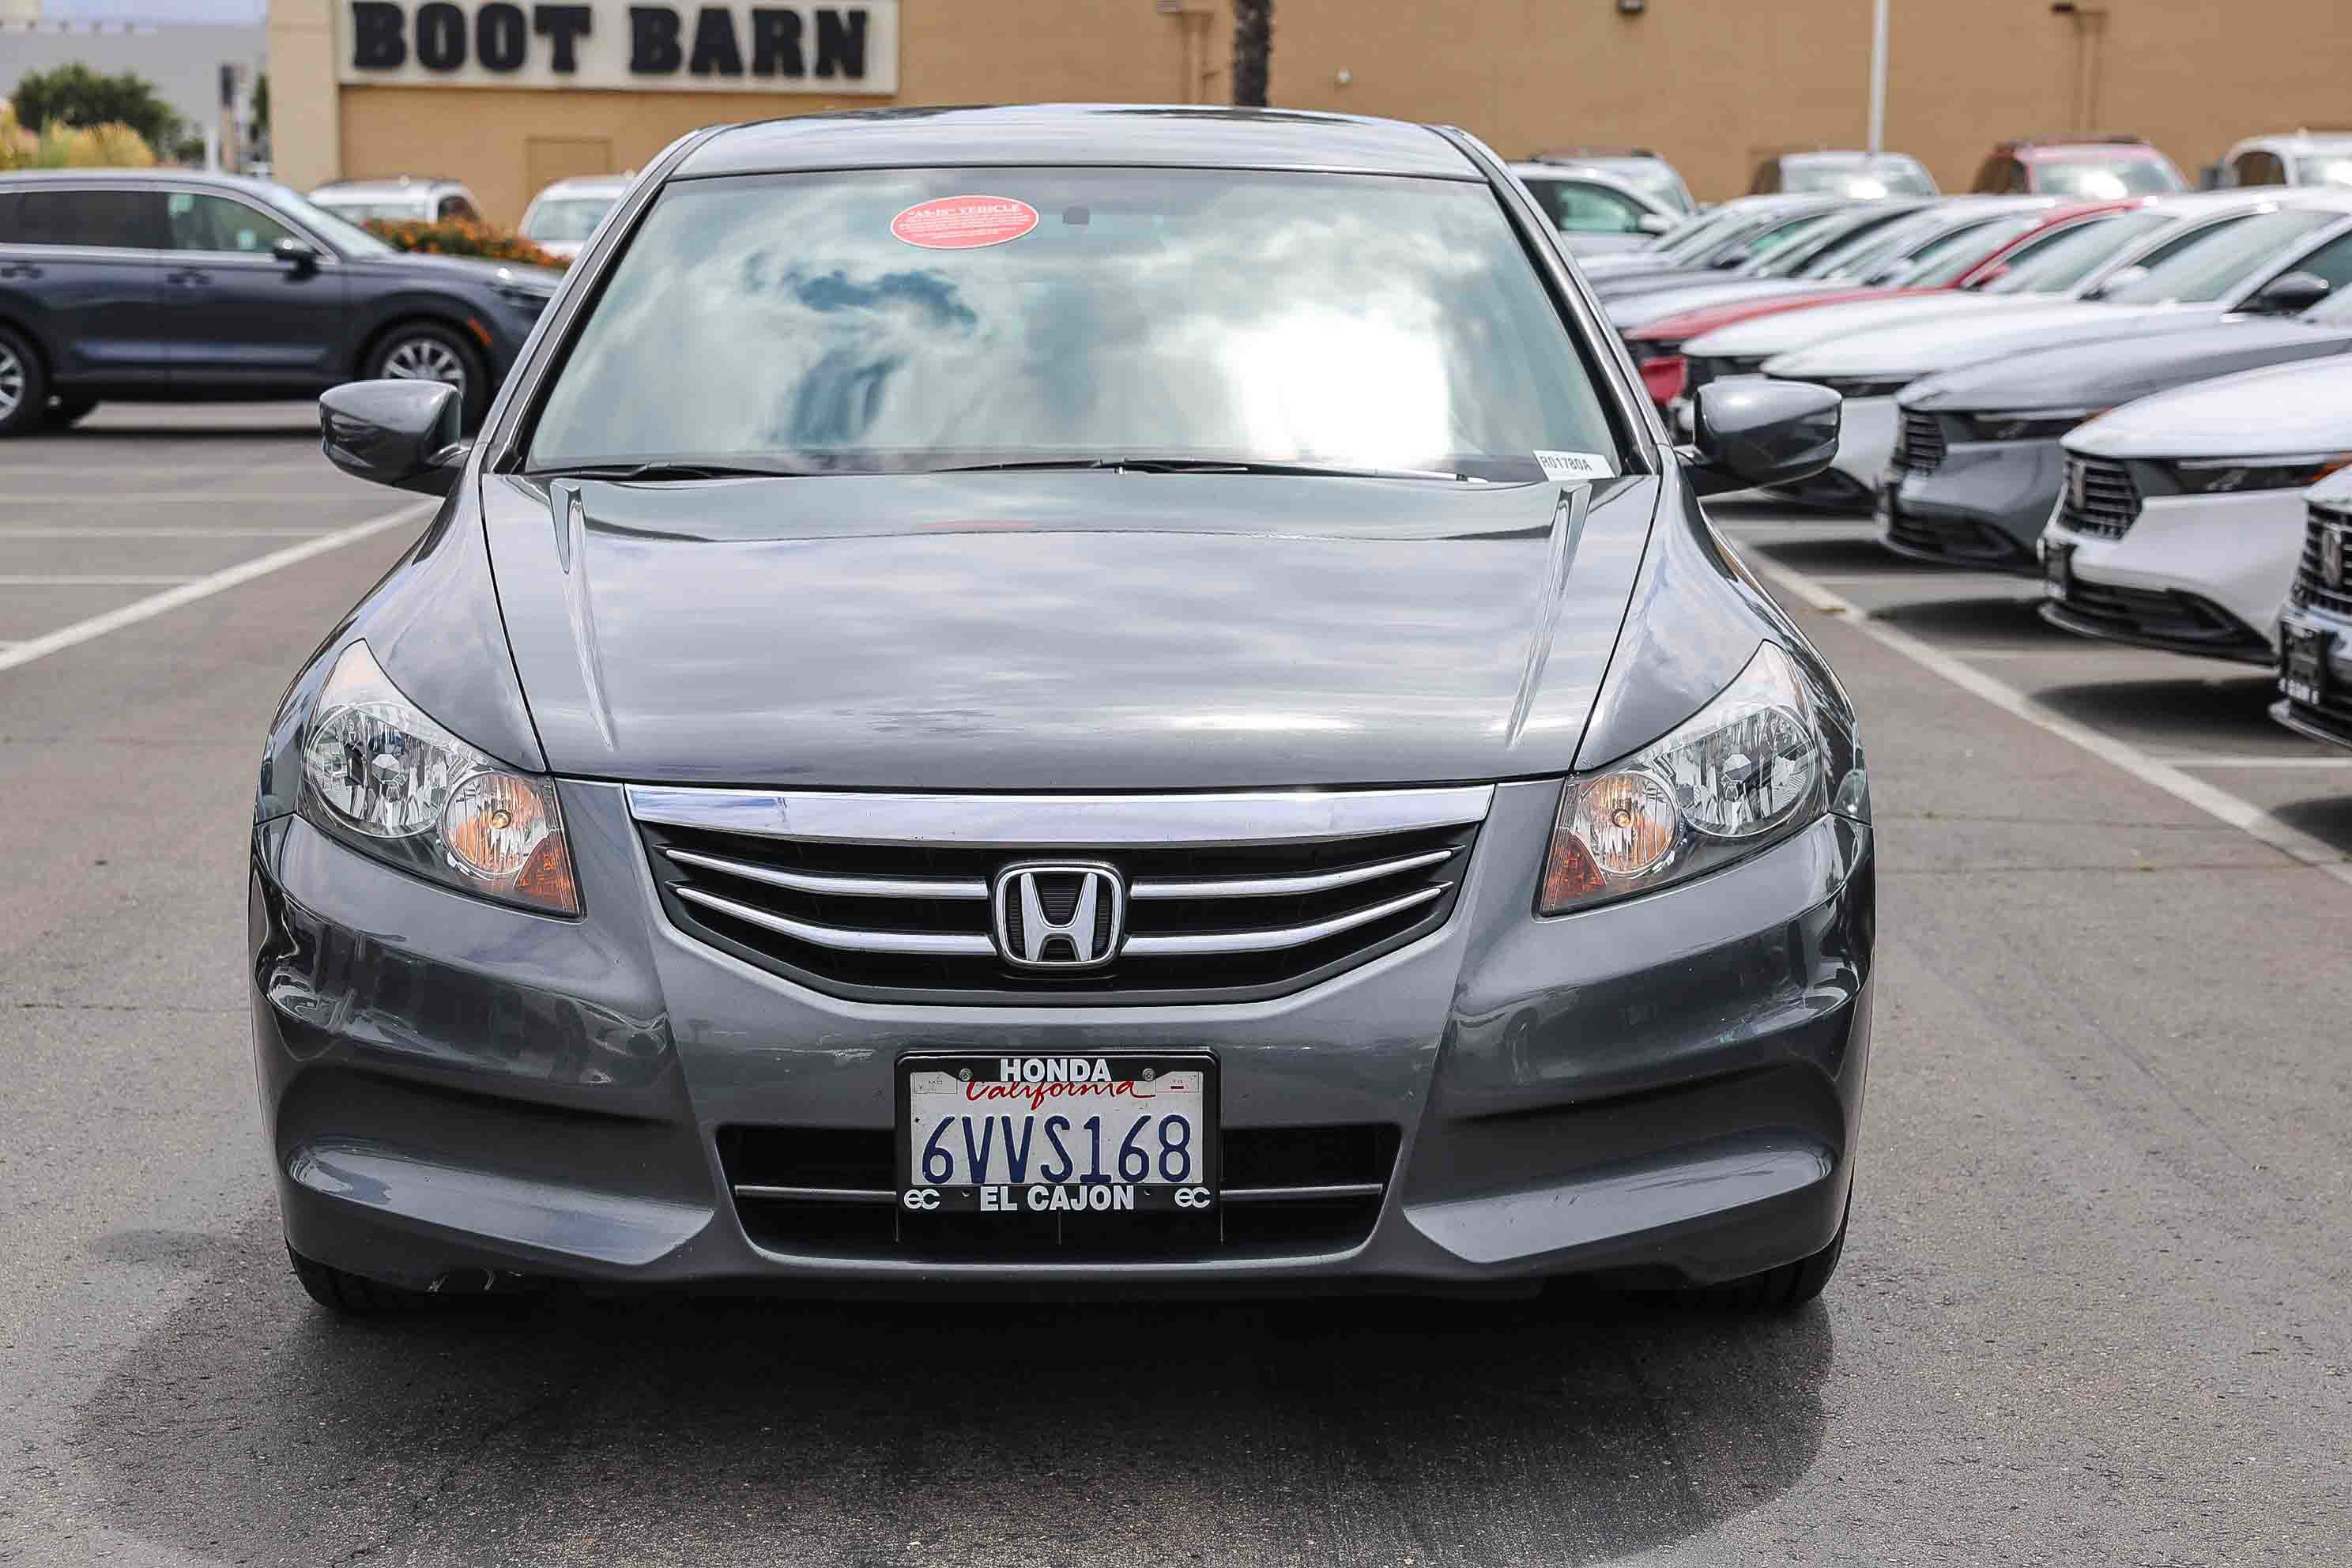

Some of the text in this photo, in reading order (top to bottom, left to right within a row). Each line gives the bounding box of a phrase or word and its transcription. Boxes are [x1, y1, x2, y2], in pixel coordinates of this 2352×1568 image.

[352, 2, 867, 80] BOOT BARN
[1000, 1058, 1111, 1082] HONDA
[922, 1115, 1190, 1183] 6VVS168
[980, 1185, 1134, 1211] EL CAJON
